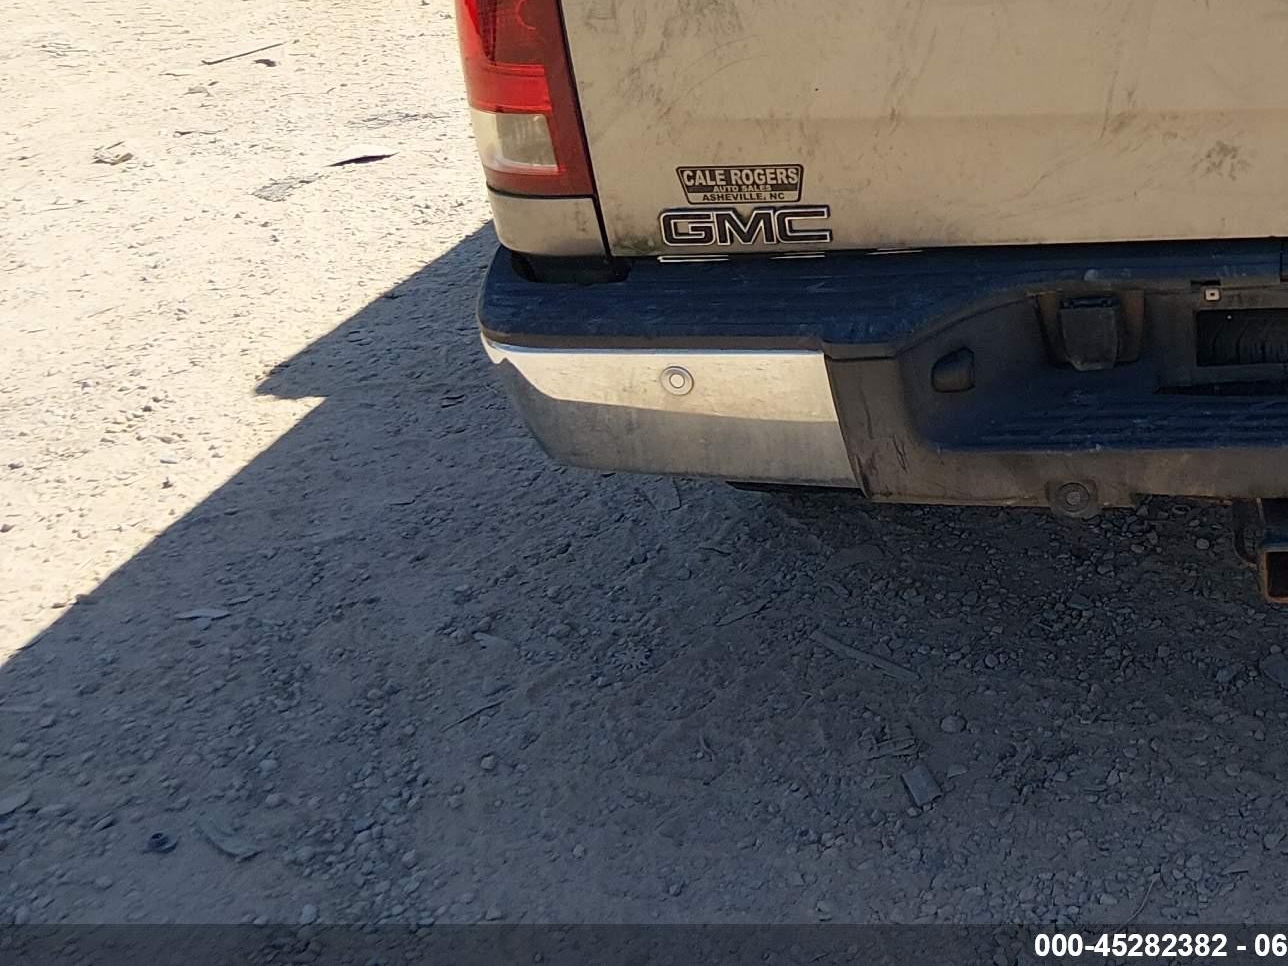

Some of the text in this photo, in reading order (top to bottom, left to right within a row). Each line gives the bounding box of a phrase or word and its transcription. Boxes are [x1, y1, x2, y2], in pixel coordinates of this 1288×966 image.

[682, 167, 797, 186] CALE ROGERS
[702, 192, 785, 202] ASHEVILLE, NC
[658, 205, 832, 247] GMC
